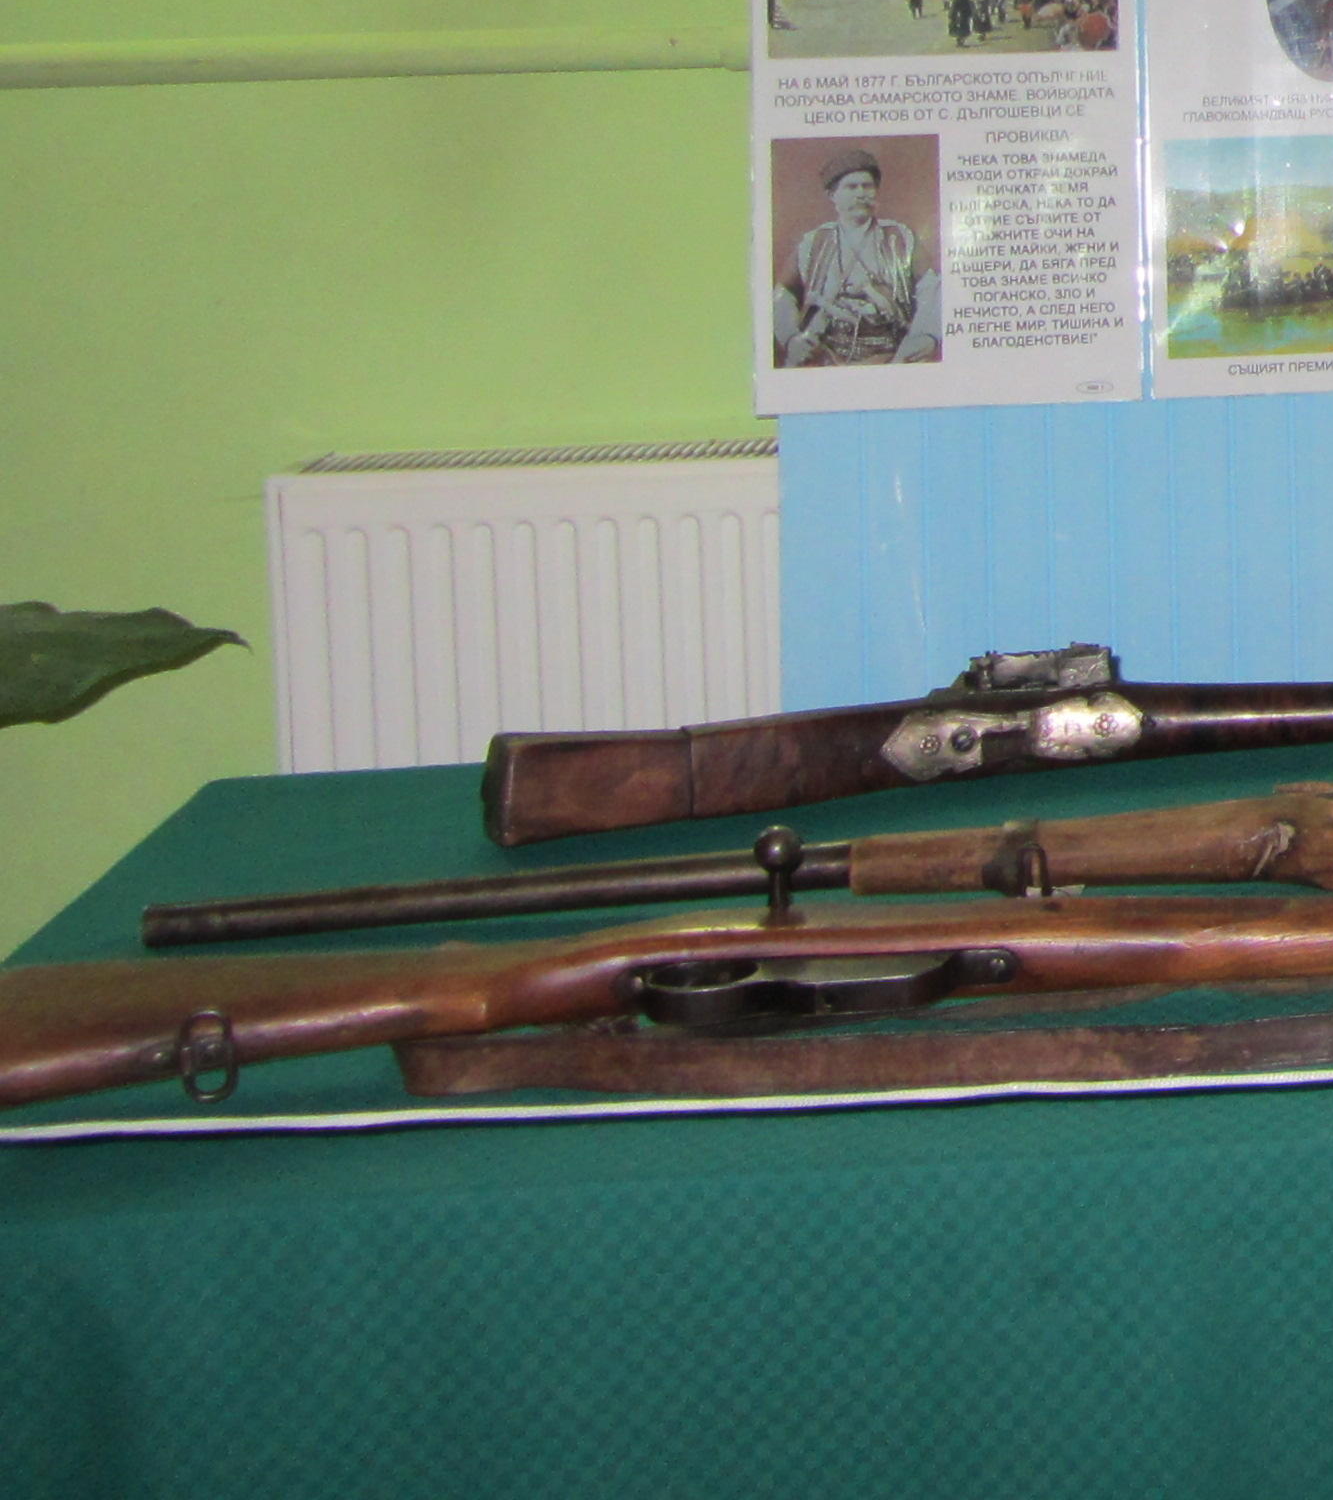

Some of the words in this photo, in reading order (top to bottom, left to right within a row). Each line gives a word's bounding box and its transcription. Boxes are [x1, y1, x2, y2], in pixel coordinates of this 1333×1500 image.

[777, 76, 798, 89] НА
[802, 76, 811, 88] 6
[815, 74, 849, 88] МАЙ
[854, 74, 885, 87] 1877
[904, 72, 1012, 86] БЪЛГАРСКОТО
[774, 93, 855, 106] ПОЛУЧАВА
[858, 90, 962, 104] САМАРСКОТО
[1025, 85, 1114, 102] ВОЙВОДАТА
[803, 110, 845, 125] ЦЕКО
[849, 109, 909, 122] ПЕТКОВ
[913, 108, 933, 121] ОТ
[956, 105, 1061, 121] ДЪЛГОШЕВЦИ
[1064, 105, 1084, 117] СЕ
[1019, 259, 1037, 272] ДА
[1041, 257, 1075, 270] БЯГА
[1079, 256, 1116, 270] ПРЕД
[961, 275, 996, 287] ТОВА
[1000, 274, 1047, 286] ЗНАМЕ
[1051, 272, 1107, 284] ВСИЧКО
[1054, 288, 1081, 300] ЗЛО
[1085, 287, 1095, 299] И
[953, 304, 1021, 319] НЕЧИСТО,
[1025, 304, 1035, 316] А
[1039, 303, 1075, 317] СЛЕД
[1079, 302, 1115, 314] НЕГО
[945, 322, 963, 335] ДА
[968, 320, 1011, 332] ЛЕГНЕ
[1052, 317, 1109, 330] ТИШИНА
[1113, 317, 1123, 328] И
[1227, 362, 1283, 377] СЪЩИЯТ
